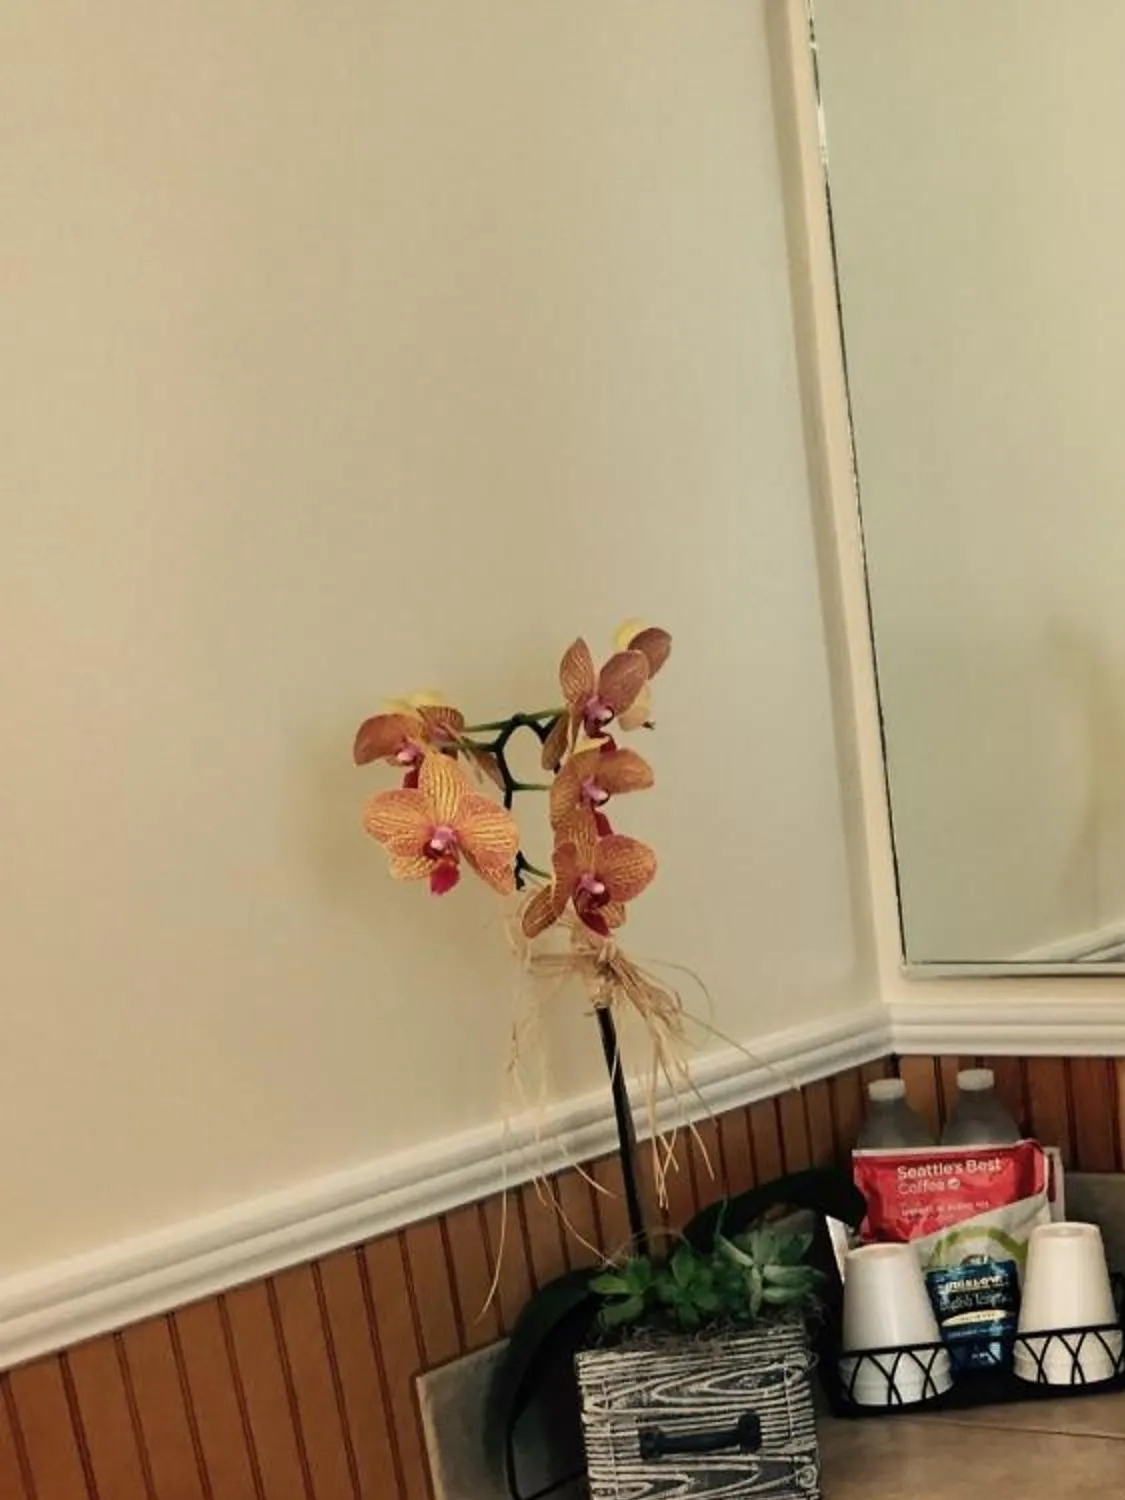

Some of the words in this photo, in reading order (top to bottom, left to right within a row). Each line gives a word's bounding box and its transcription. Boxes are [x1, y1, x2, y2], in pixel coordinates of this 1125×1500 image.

[897, 1162, 964, 1179] Seattle's
[966, 1157, 1002, 1174] Best
[898, 1179, 945, 1196] Coffee
